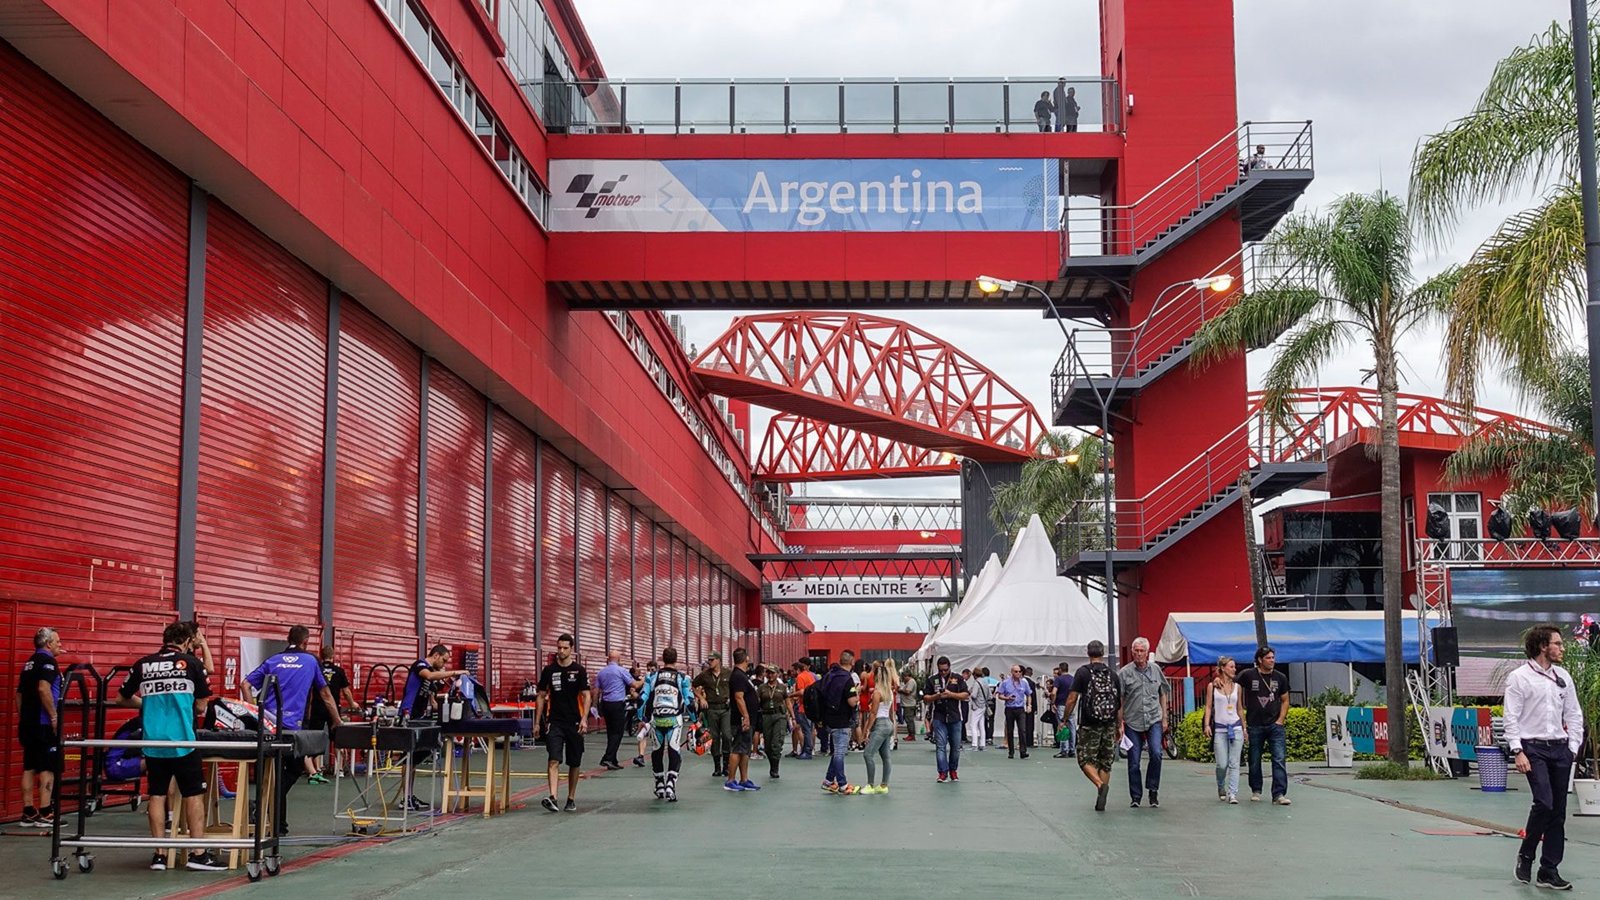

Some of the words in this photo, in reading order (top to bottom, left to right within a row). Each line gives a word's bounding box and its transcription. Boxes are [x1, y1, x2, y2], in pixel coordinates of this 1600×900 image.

[743, 168, 983, 226] Argentina
[804, 583, 849, 596] MEDIA
[853, 582, 908, 596] CENTRE
[142, 661, 174, 674] MB
[154, 681, 187, 693] Beta
[1346, 720, 1374, 739] PADDOCK
[1374, 721, 1389, 741] BAR
[1451, 724, 1478, 745] PADDOCK
[1478, 725, 1491, 746] BAR
